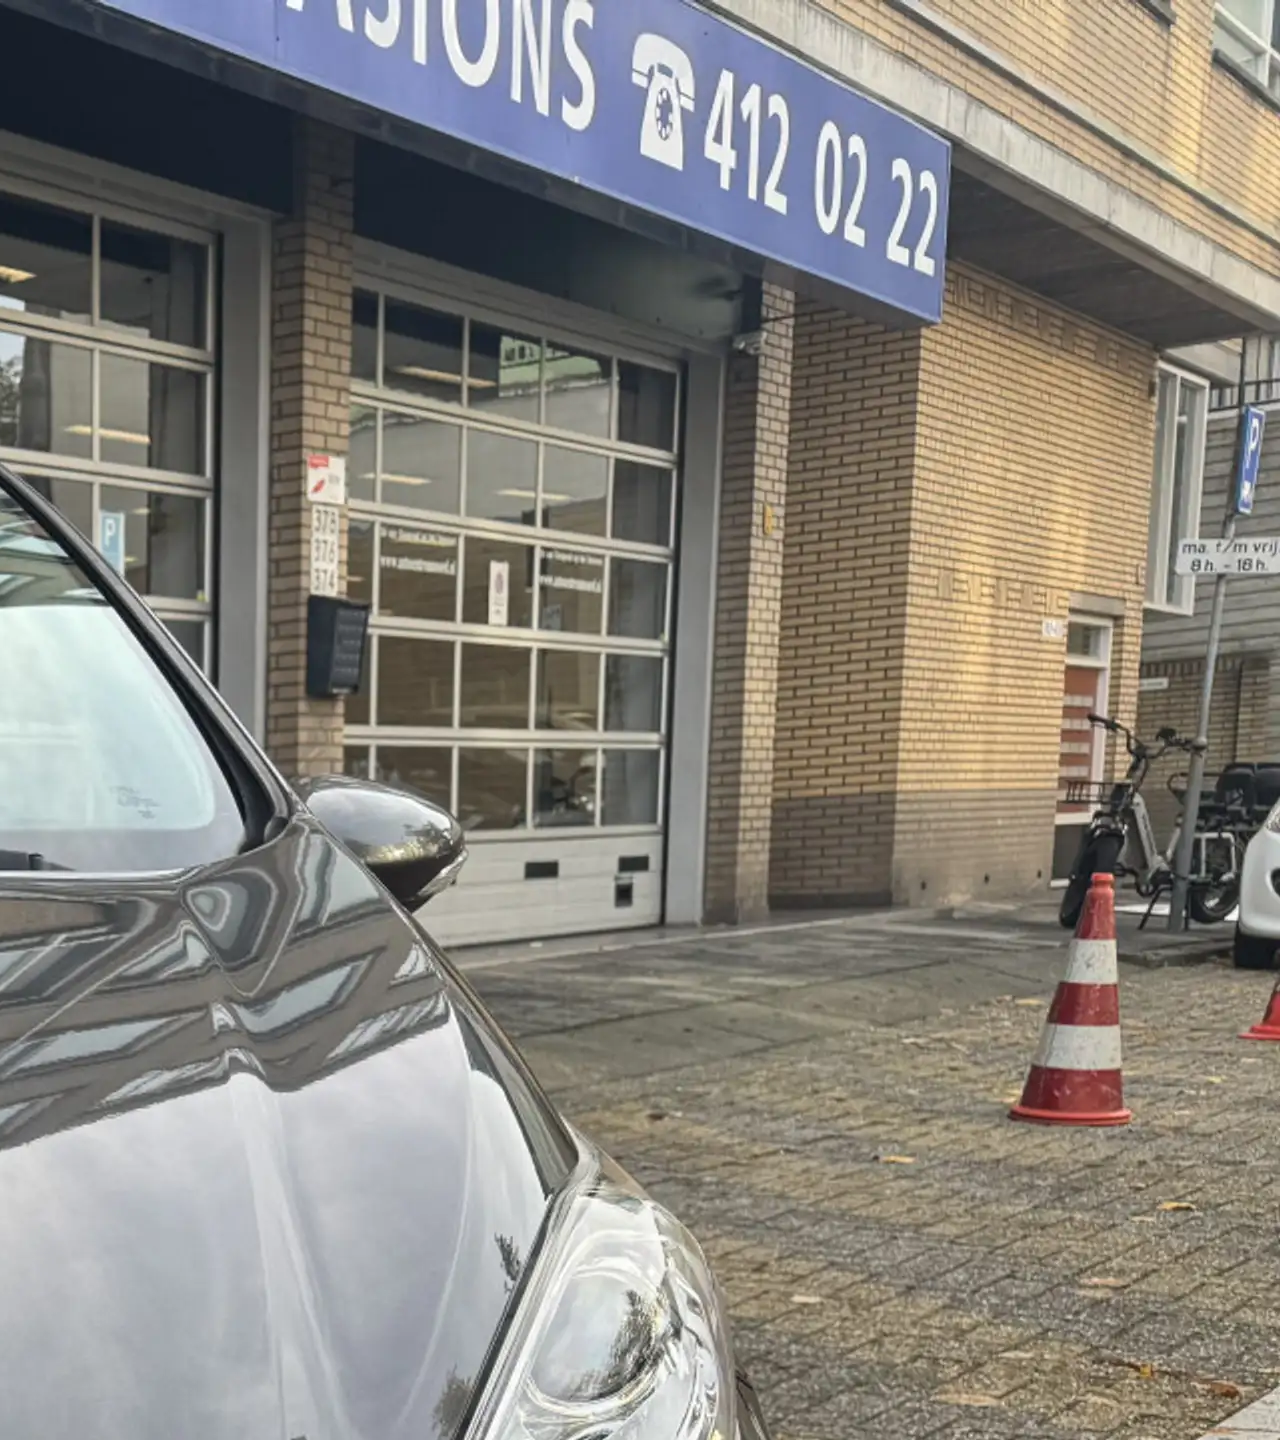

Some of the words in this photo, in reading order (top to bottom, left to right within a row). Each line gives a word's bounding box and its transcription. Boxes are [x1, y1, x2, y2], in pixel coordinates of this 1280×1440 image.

[704, 70, 790, 214] 412
[815, 121, 868, 247] 02
[886, 157, 939, 276] 22
